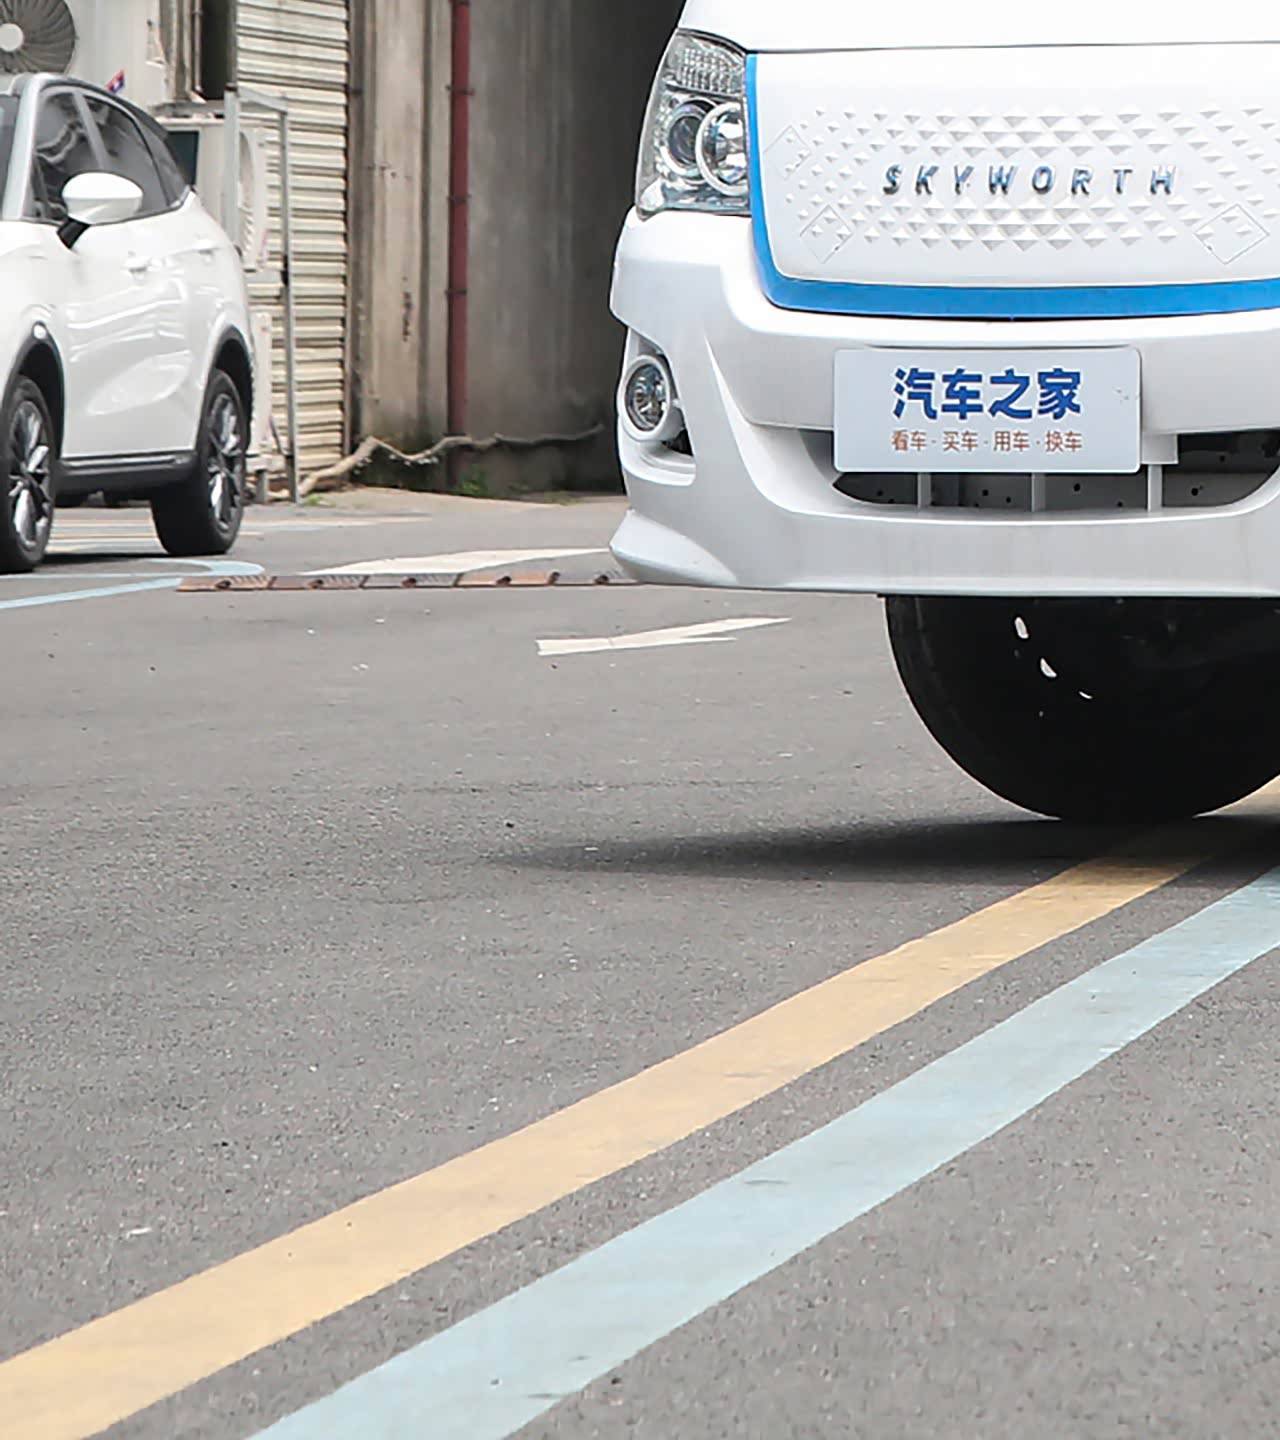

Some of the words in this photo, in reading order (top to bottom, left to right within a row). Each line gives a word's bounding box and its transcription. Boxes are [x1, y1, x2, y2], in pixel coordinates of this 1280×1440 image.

[882, 164, 1176, 196] SKYWORTH
[893, 367, 1081, 420] 汽车之家
